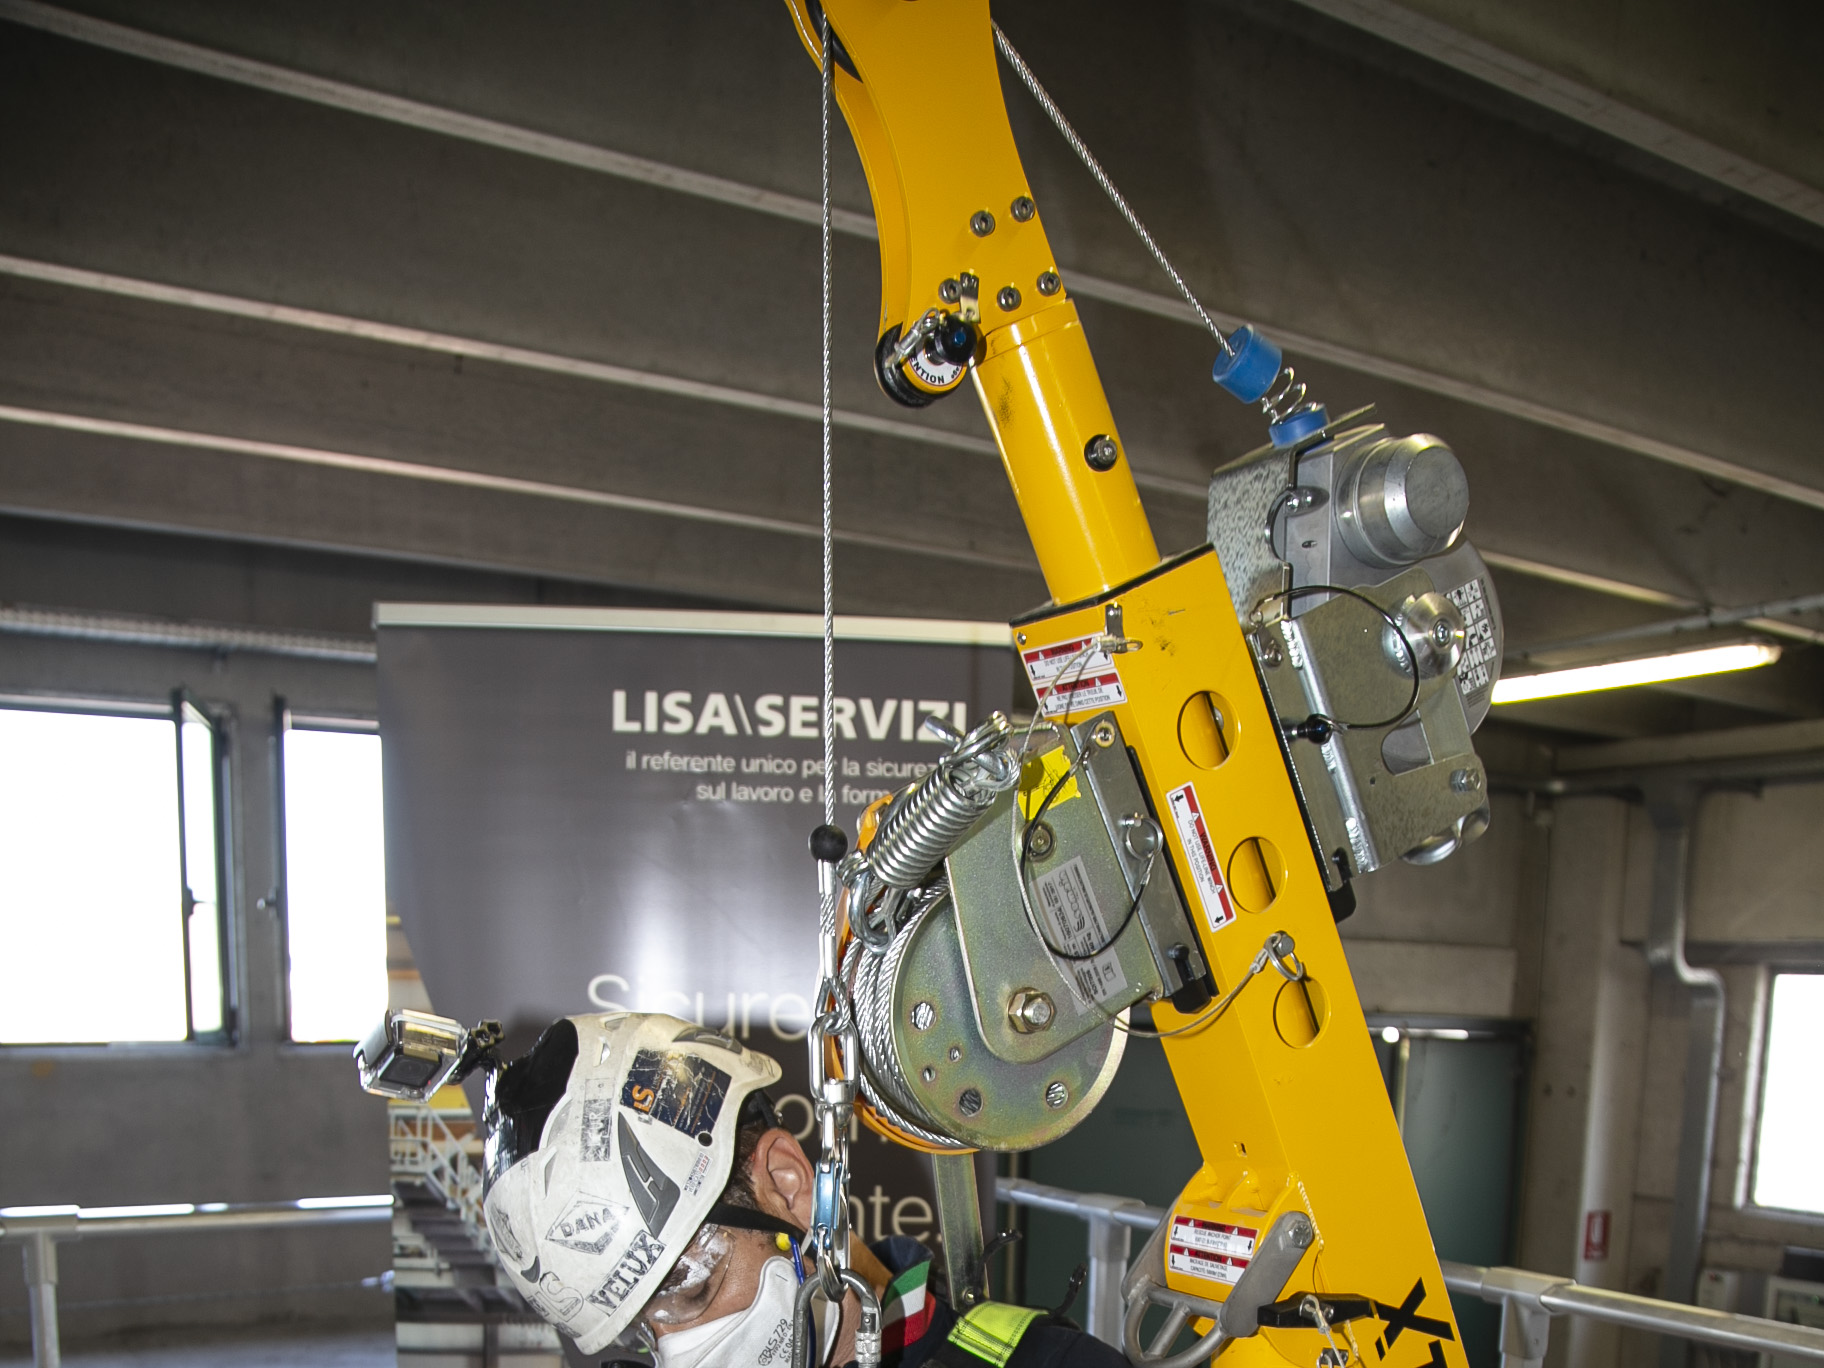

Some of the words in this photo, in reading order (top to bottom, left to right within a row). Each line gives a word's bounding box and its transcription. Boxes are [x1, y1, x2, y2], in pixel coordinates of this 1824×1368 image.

[626, 750, 636, 770] il
[641, 751, 736, 773] referente
[741, 755, 797, 775] unico
[843, 757, 861, 777] la
[696, 782, 724, 801] sul
[731, 782, 794, 802] lavoro
[799, 787, 813, 803] e
[1189, 828, 1198, 840] NOT
[1197, 832, 1218, 871] WARNING
[590, 1233, 667, 1312] VELUX
[760, 1336, 778, 1357] BLS
[772, 1317, 789, 1338] 729
